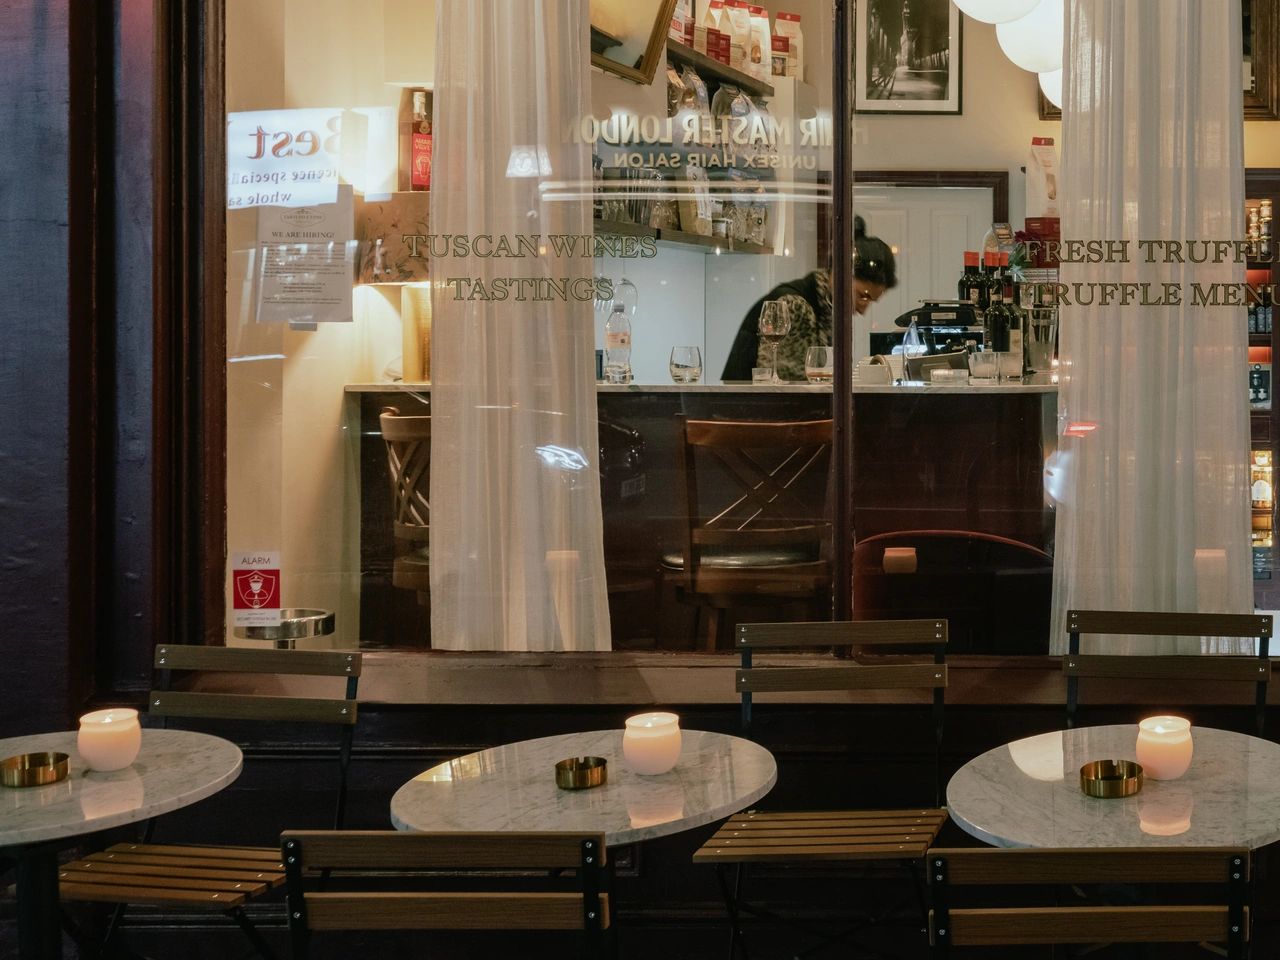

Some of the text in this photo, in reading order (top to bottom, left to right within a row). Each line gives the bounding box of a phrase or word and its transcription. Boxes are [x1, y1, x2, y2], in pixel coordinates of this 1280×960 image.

[286, 231, 301, 239] ARE
[402, 234, 658, 259] TUSCAN WINES
[1023, 240, 1131, 264] FRESH
[446, 277, 615, 302] TASTINGS
[1025, 283, 1182, 306] TRUFFLE
[240, 556, 271, 565] ALARM
